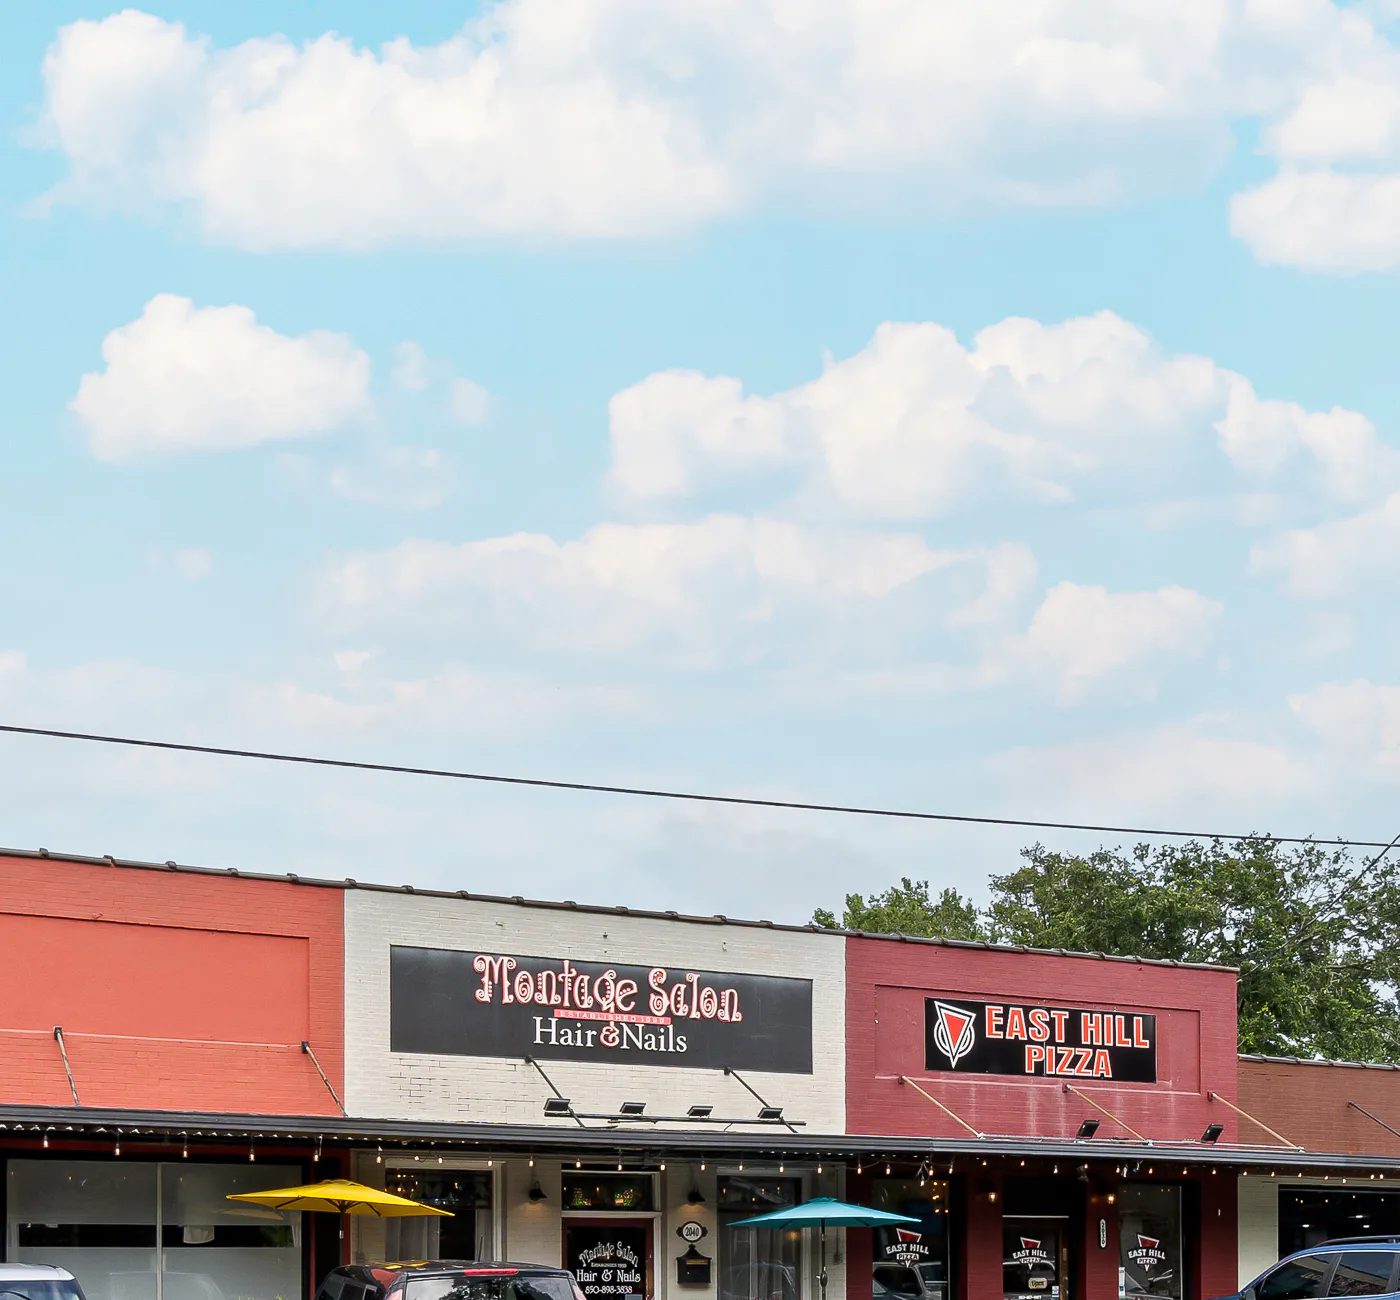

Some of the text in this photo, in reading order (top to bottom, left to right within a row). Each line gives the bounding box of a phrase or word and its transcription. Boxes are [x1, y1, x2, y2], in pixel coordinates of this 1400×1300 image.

[473, 955, 743, 1023] Montage Salon
[559, 1011, 665, 1025] ESTABLISHED 1999
[985, 1005, 1150, 1048] EAST HILL
[1025, 1045, 1113, 1078] PIZZA
[685, 1226, 700, 1237] 2040
[885, 1243, 929, 1255] EAST HILL
[1012, 1249, 1047, 1259] EAST HILL
[1128, 1249, 1166, 1260] EAST HILL
[576, 1269, 641, 1283] Hair & Nails
[585, 1285, 633, 1294] 850-898-3838
